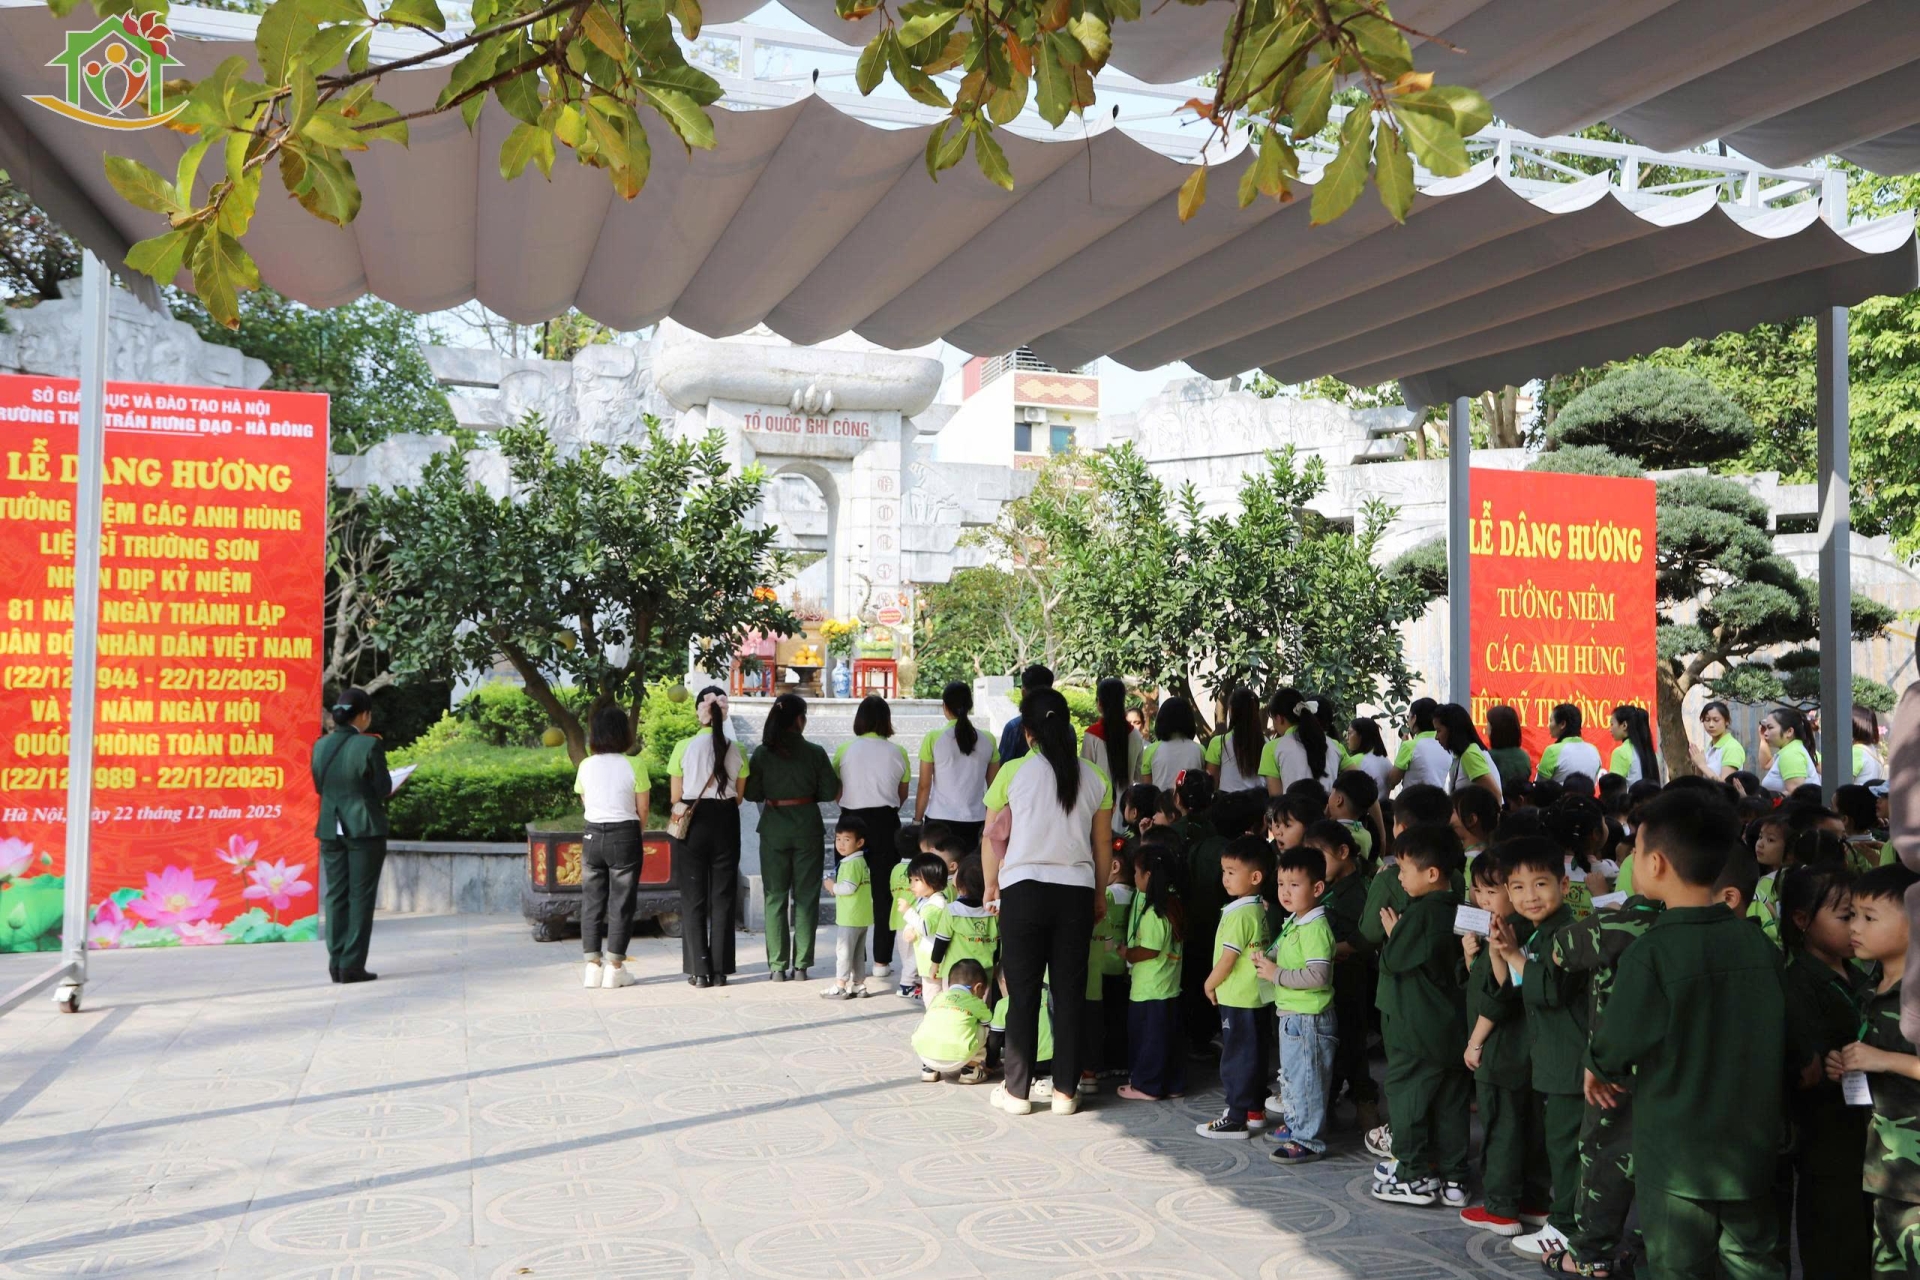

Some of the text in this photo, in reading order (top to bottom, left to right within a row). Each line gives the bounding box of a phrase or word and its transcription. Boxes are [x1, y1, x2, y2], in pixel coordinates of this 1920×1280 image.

[57, 389, 81, 405] GIÁ
[103, 393, 130, 410] ỤC
[132, 392, 153, 409] VÀ
[156, 394, 187, 411] ĐÀO
[190, 398, 219, 415] TẠO
[222, 398, 242, 414] HÀ
[244, 400, 271, 418] NỘI
[0, 404, 55, 424] RƯỜNG
[151, 414, 196, 432] HƯNG
[199, 418, 232, 435] ĐẠO
[246, 419, 267, 435] HÀ
[270, 420, 314, 438] ĐÔNG
[744, 408, 869, 438] TỔ QUỐC GHI CÔNG
[6, 438, 51, 482] LỄ
[171, 457, 292, 493] HƯƠNG
[102, 497, 136, 529] ỆM
[142, 499, 187, 526] CÁC
[192, 505, 238, 529] ANH
[243, 504, 301, 531] HÙNG
[40, 528, 76, 560] LIỆ
[122, 531, 209, 560] TRƯỜNG
[215, 537, 259, 561] SƠN
[1469, 500, 1642, 563] LỄ DÂNG HƯƠNG
[47, 563, 252, 597] NHN DỊP KỶ NIỆM
[8, 595, 286, 630] 81 NĂ NGÀY THÀNH LẬP
[1497, 578, 1615, 629] TƯỞNG NIỆM
[47, 629, 74, 660] ĐỘ
[97, 630, 156, 656] NHÂN
[161, 631, 207, 657] DÂN
[212, 632, 258, 663] VIỆT
[263, 637, 312, 659] NAM
[1485, 633, 1626, 675] CÁC ANH HÙNG
[4, 666, 138, 690] (22/12944
[160, 667, 286, 693] 22/12/2025)
[30, 695, 61, 722] VÀ
[101, 696, 154, 722] NĂM
[160, 697, 219, 723] NGÀY
[224, 697, 260, 727] HỘI
[166, 729, 223, 756] TOÀN
[229, 729, 274, 756] DÂN
[1, 766, 136, 792] (22/12989
[157, 766, 284, 790] 22/12/2025)
[2, 804, 282, 824] Hà Nội, ày 22 tháng 12 năm 2025
